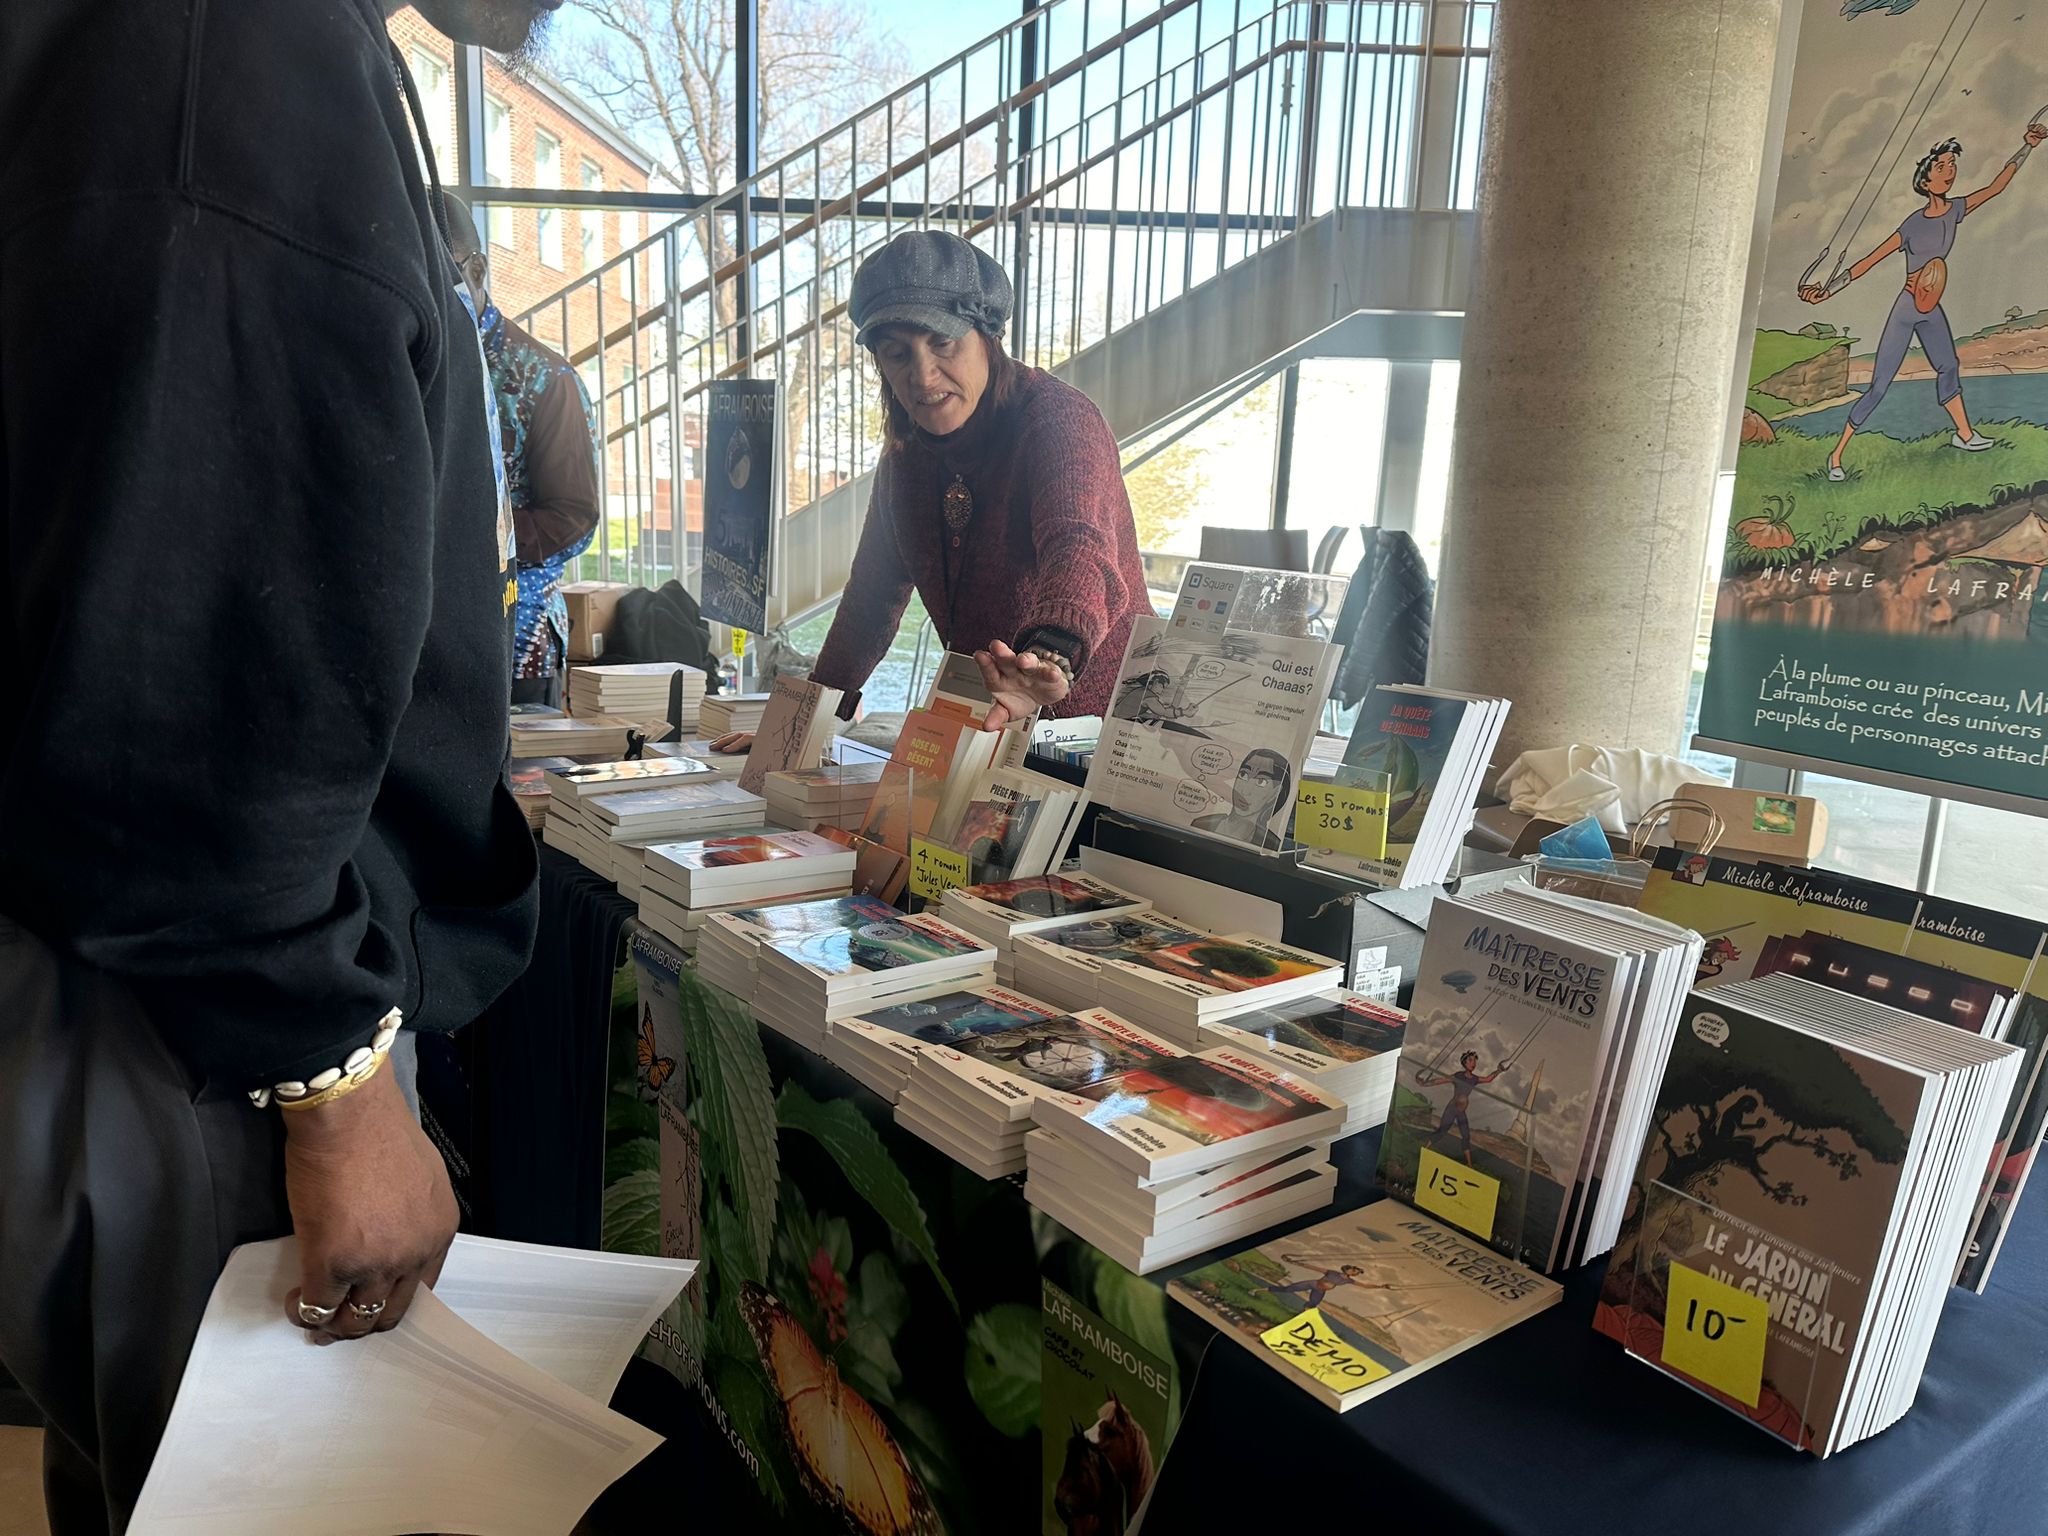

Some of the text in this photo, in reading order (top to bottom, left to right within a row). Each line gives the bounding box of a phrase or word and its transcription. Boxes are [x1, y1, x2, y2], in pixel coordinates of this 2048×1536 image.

[751, 574, 765, 598] SF
[1202, 576, 1236, 592] Square
[1759, 564, 1876, 588] MICHÈLE
[1272, 659, 1314, 678] Qui est
[1768, 654, 1788, 681] À
[1791, 659, 1806, 681] la
[1808, 663, 1862, 690] plume
[1865, 677, 1891, 692] ou
[1896, 682, 1919, 696] au
[1922, 682, 2011, 712] pinceau,
[1261, 675, 1314, 696] Chaaas?
[1759, 678, 2042, 739] Laframboise crée des univers
[1043, 729, 1077, 742] Pour
[1754, 706, 1821, 732] peuplés
[1824, 711, 1848, 733] de
[1850, 723, 1978, 758] personnages
[905, 751, 936, 769] DÉSERT
[989, 783, 1009, 799] PIÈGE
[1297, 789, 1384, 817] Les 5 romans
[1318, 813, 1354, 831] 30$
[917, 848, 961, 874] 4 romans
[1722, 866, 1869, 913] Michèle Laframboise
[1916, 912, 1986, 944] ramboise
[631, 932, 682, 976] LAFRAMBOISE
[1464, 925, 1606, 991] MAÎTRESSE
[1487, 962, 1597, 1017] DES VENTS
[1091, 1013, 1106, 1022] LA
[1102, 1018, 1130, 1034] QUÊTE
[1126, 1031, 1142, 1041] DE
[1217, 1053, 1234, 1062] LA
[1230, 1058, 1265, 1074] QUÊTE
[1260, 1071, 1278, 1080] DE
[1397, 1221, 1545, 1294] MAÎTRESSE
[1412, 1240, 1448, 1261] DES
[1446, 1257, 1526, 1301] VENTS
[1703, 1223, 1830, 1306] LE JARDIN
[1042, 1290, 1168, 1401] LAFRAMBOISE
[1044, 1340, 1096, 1381] CHOCOLAT
[648, 1318, 760, 1479] CHOFICTIONS.com
